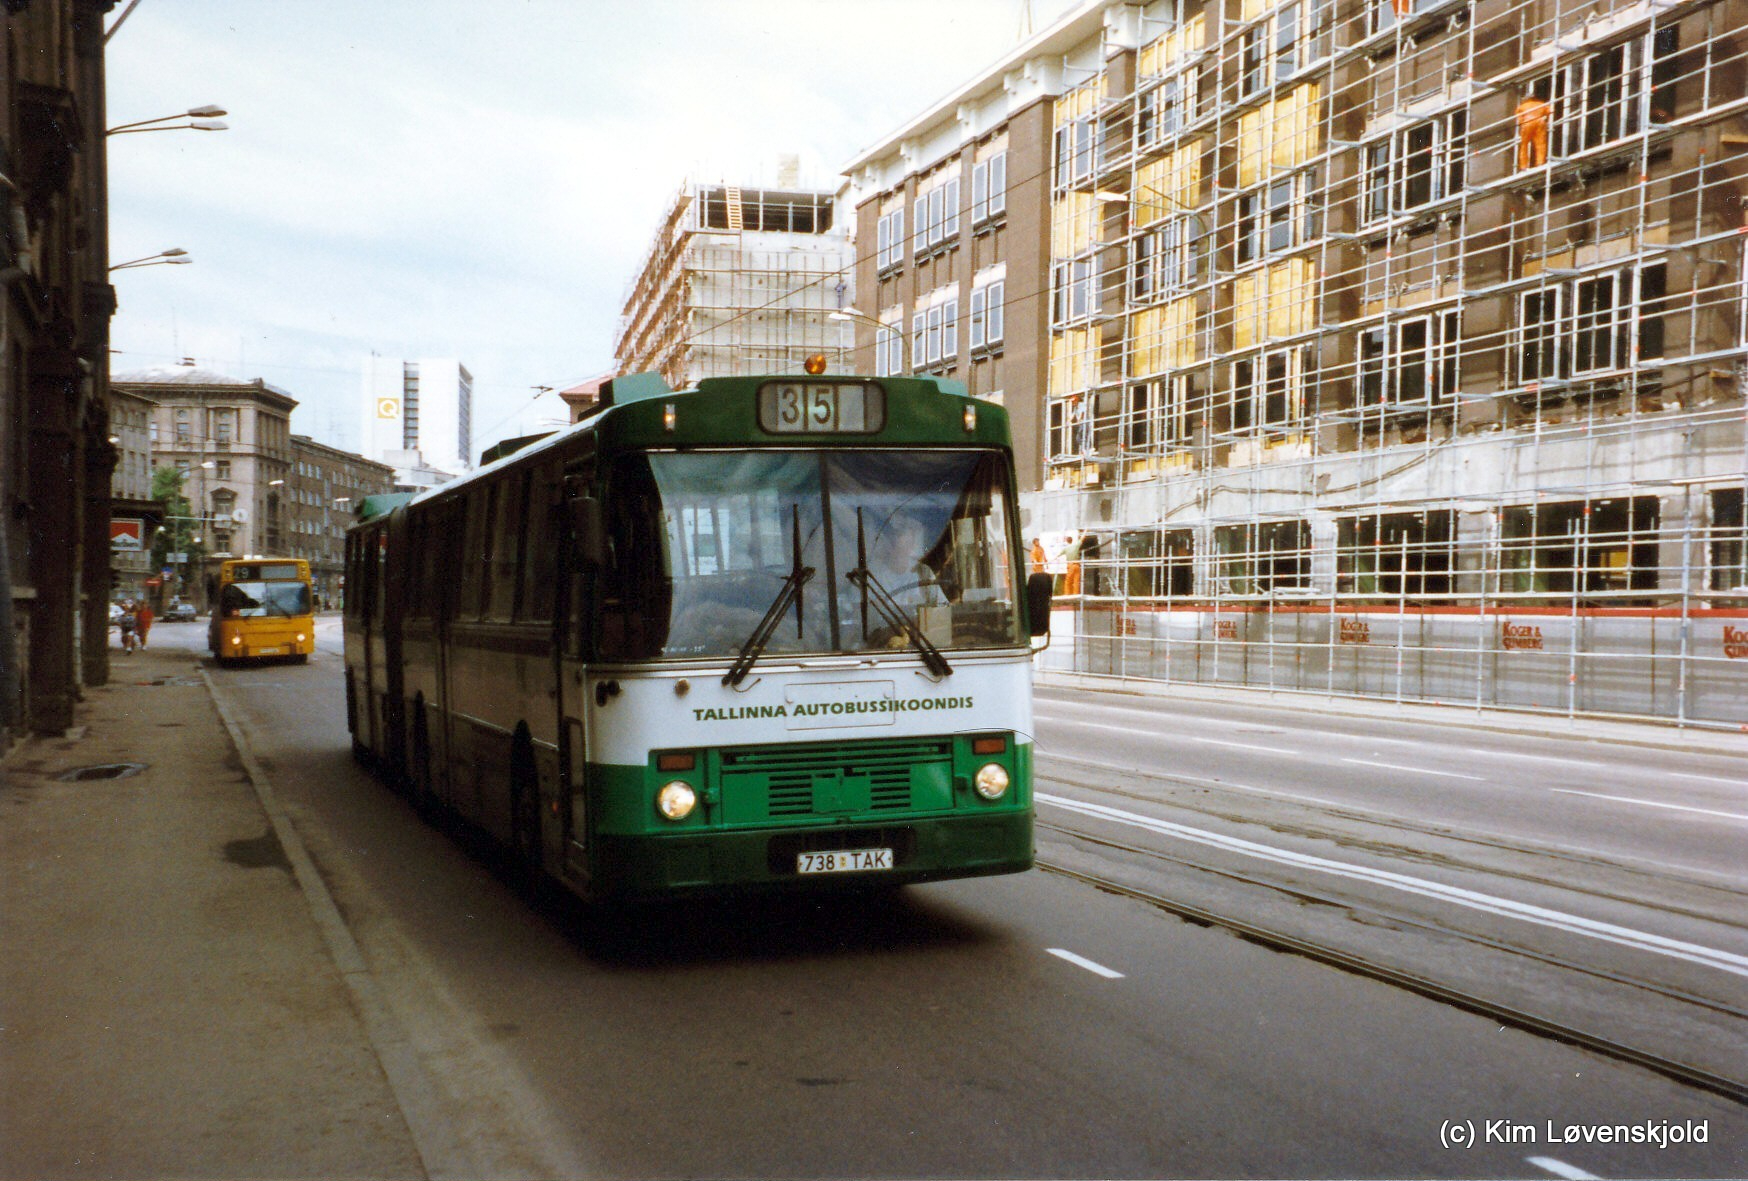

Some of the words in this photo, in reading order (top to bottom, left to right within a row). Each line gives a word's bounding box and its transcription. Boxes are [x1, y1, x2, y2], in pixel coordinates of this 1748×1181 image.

[379, 399, 399, 418] Q
[782, 387, 831, 425] 35
[1503, 621, 1533, 637] KOGER
[693, 705, 787, 721] TALLINNA
[793, 696, 974, 717] AUTOBUSSIKOONDIS
[804, 854, 836, 872] 738
[850, 852, 886, 869] TAK
